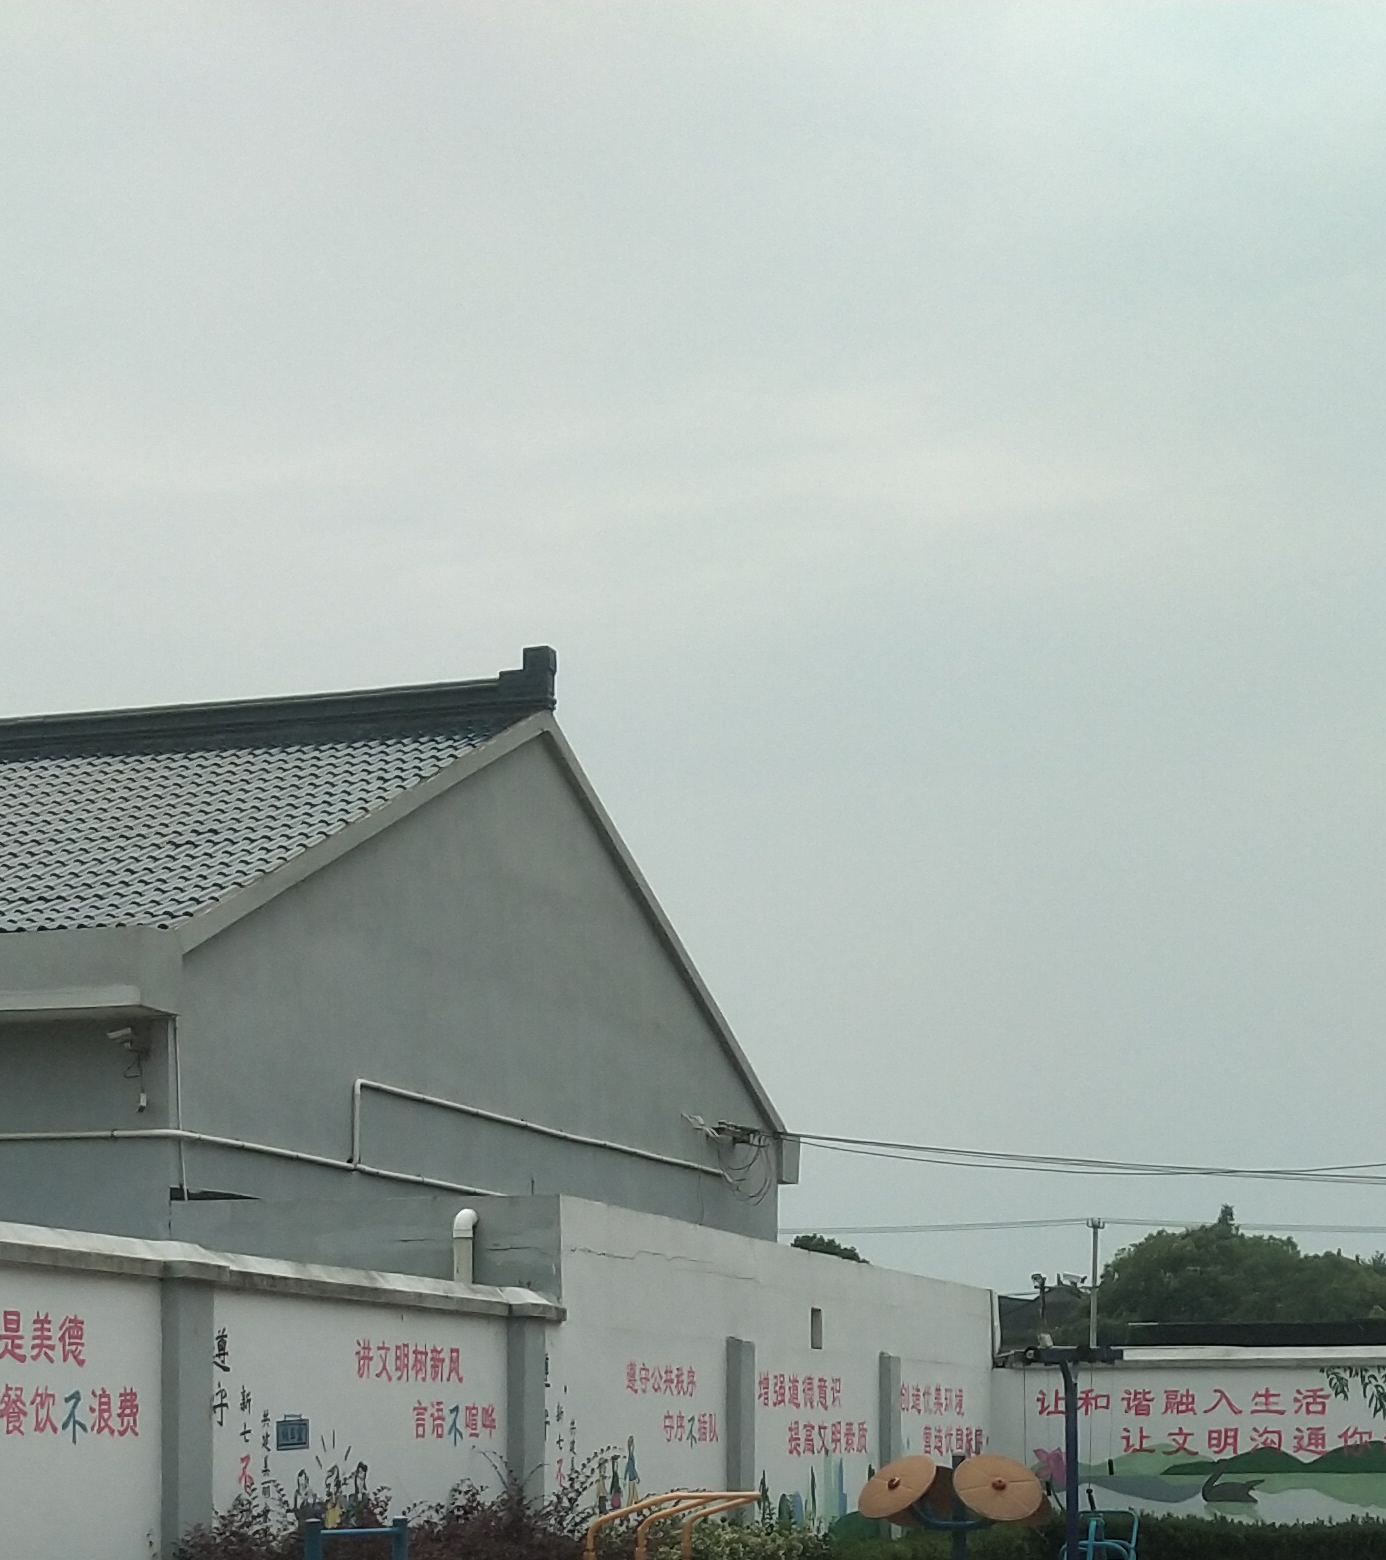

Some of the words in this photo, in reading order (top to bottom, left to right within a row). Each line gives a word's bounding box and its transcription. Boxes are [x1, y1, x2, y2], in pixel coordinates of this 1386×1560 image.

[355, 1338, 463, 1383] 讲文明树新风
[626, 1360, 697, 1397] 遵守公共秩序
[758, 1371, 841, 1411] 增强道德意识
[1036, 1387, 1332, 1417] 让和谐融入生活
[0, 1384, 140, 1445] 餐饮不浪费
[412, 1400, 497, 1447] 言语不喧哗
[663, 1410, 719, 1449] 守序不插队
[788, 1420, 868, 1457] 提高文明素质
